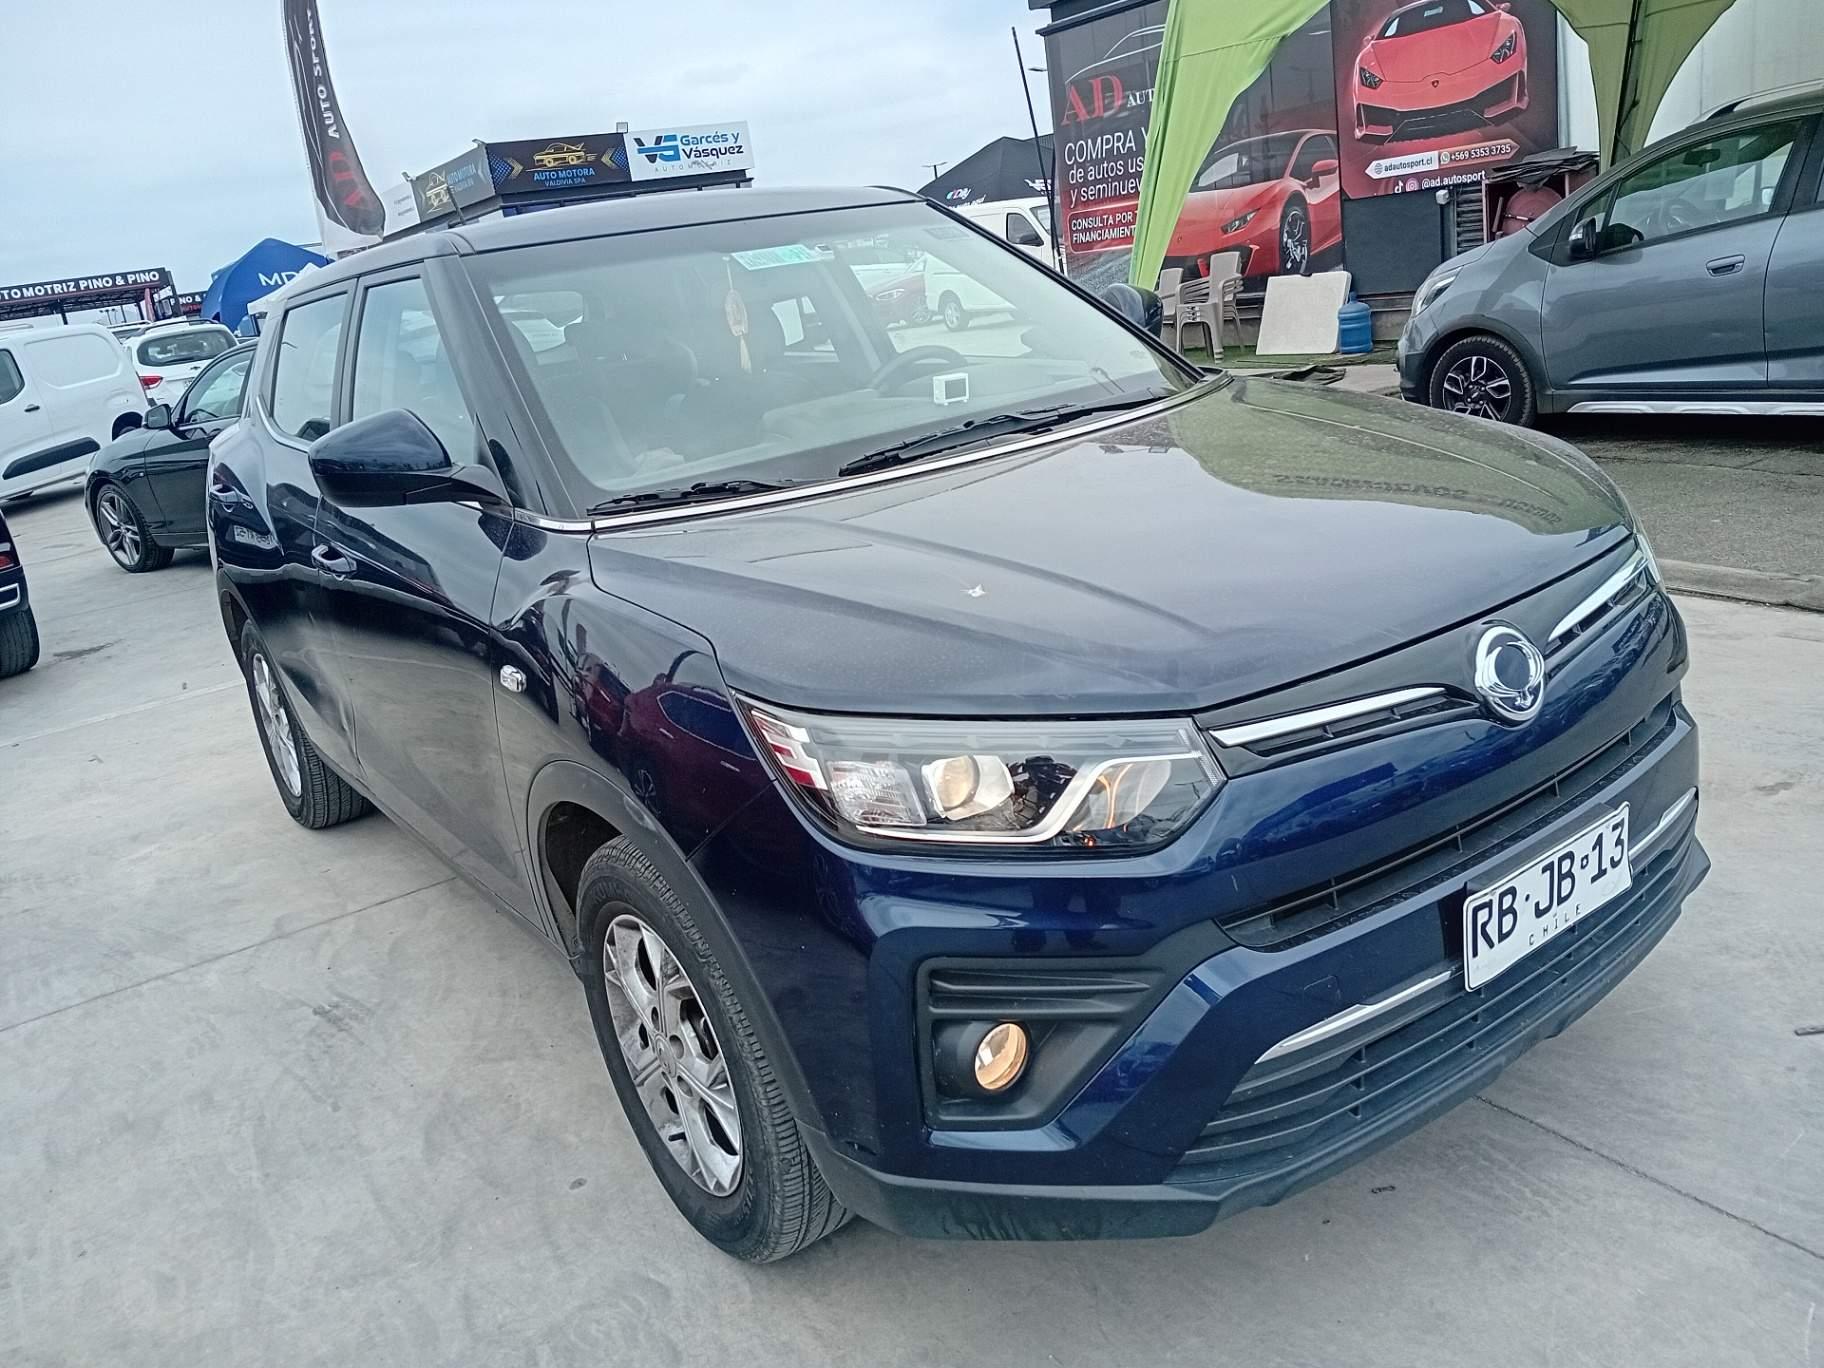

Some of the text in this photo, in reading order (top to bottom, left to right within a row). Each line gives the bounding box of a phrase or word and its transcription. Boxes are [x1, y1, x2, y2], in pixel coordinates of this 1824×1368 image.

[1061, 73, 1156, 126] AD AUT
[317, 86, 340, 139] AUTO
[680, 131, 740, 146] Garcés y
[1064, 130, 1136, 165] COMPRA
[681, 144, 744, 159] Vásquez
[1450, 143, 1511, 161] +569 5353 3735
[1069, 156, 1145, 184] de autos us
[1384, 157, 1433, 172] adautosport.cl
[534, 167, 595, 182] AUTO MOTORA
[545, 178, 573, 187] VALDIVIA
[1421, 170, 1486, 189] @ad.autosport
[1070, 179, 1141, 208] y seminuev
[1071, 214, 1114, 231] CONSULTA
[1115, 209, 1133, 225] POR
[1072, 225, 1136, 244] FINANCIAMIENT
[79, 277, 113, 291] PINO
[115, 274, 126, 286] &
[127, 271, 160, 285] PINO
[1528, 903, 1582, 946] CHILE
